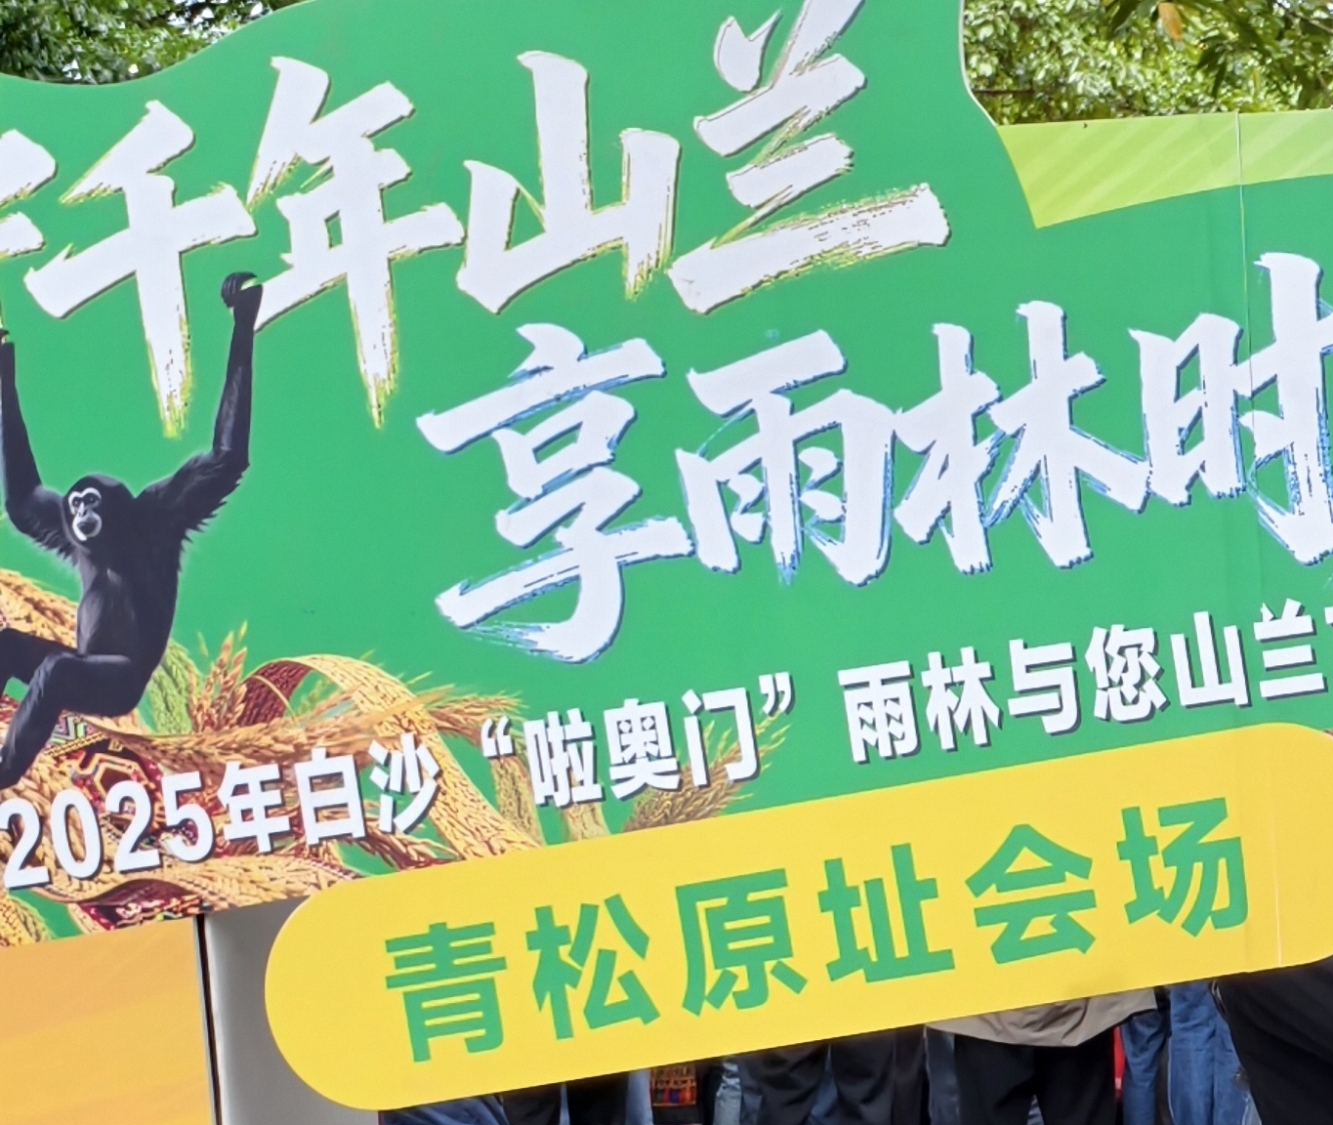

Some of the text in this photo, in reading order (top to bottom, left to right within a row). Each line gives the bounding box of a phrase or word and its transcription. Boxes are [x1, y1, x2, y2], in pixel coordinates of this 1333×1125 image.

[0, 0, 952, 440] 千年山兰
[384, 795, 1250, 1064] 青松原址会场
